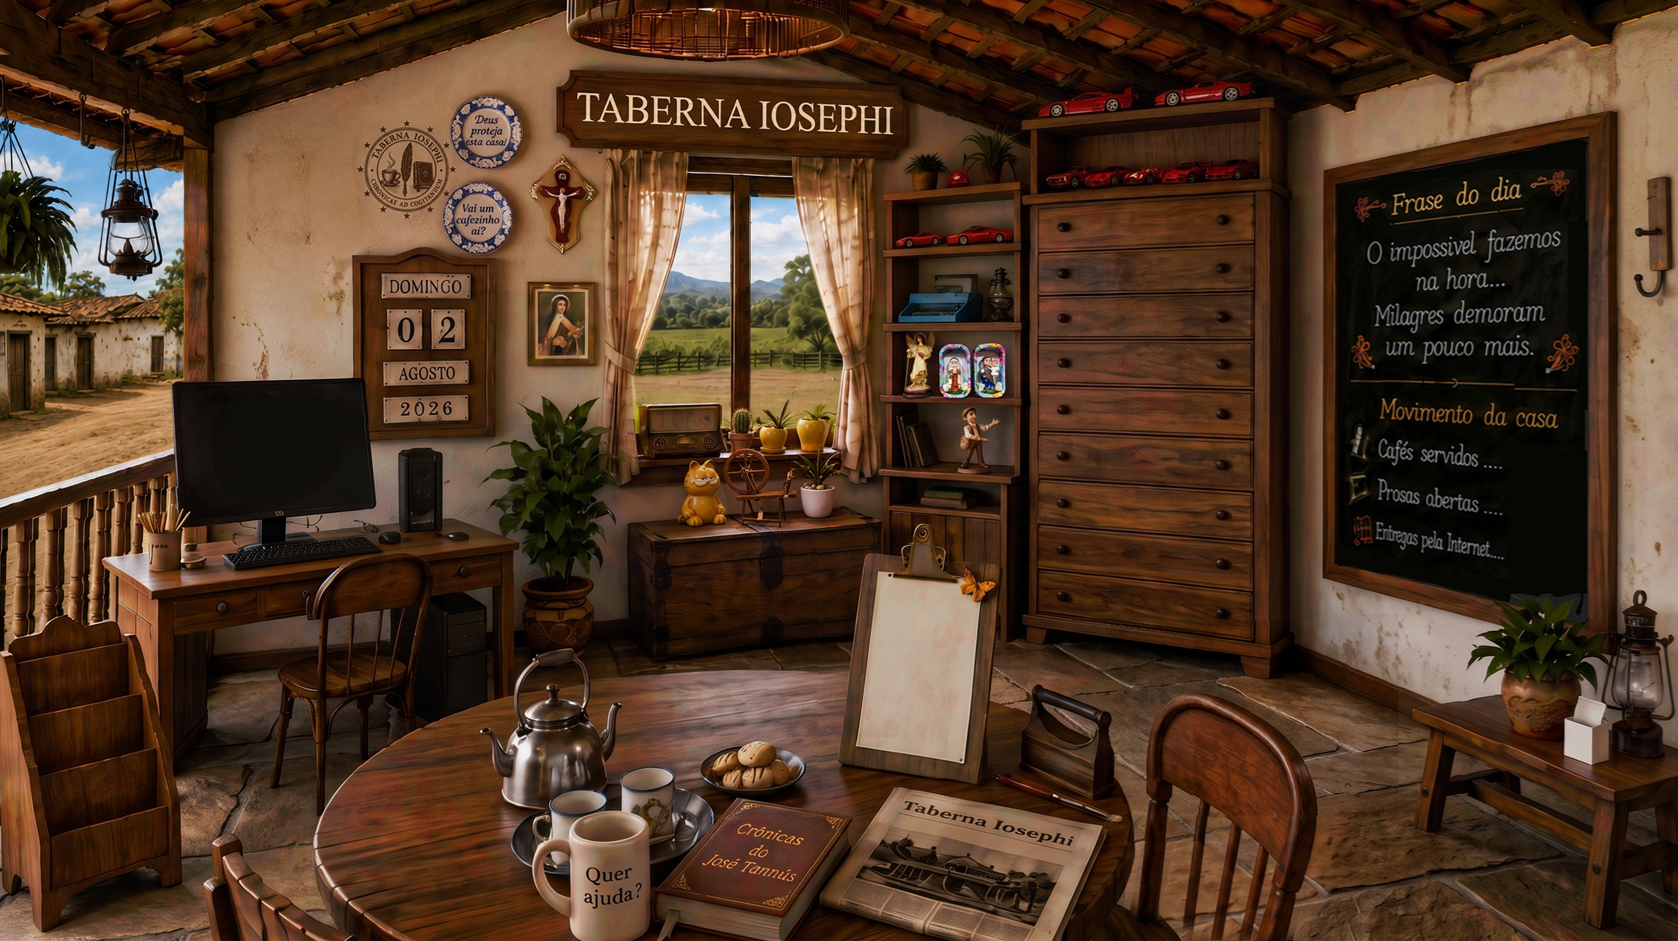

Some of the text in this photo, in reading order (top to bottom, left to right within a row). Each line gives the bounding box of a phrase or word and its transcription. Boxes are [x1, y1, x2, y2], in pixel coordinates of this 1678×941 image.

[474, 115, 498, 124] Deus
[577, 92, 894, 135] TABERNA IOSEPHI
[470, 126, 502, 138] proteja
[486, 138, 507, 146] casa!
[371, 132, 443, 163] TABERNA IOSEPHI
[370, 179, 397, 206] CHRONICAE
[410, 179, 443, 208] COGITANDUM
[1391, 176, 1522, 216] Frase do dia
[456, 215, 500, 226] cafezinho
[462, 204, 478, 212] Vai
[1366, 230, 1561, 268] O impossivel fazemos
[390, 280, 462, 294] DOMINGO
[1416, 268, 1506, 292] na hora...
[1374, 300, 1546, 334] Milagres demoram
[1385, 335, 1534, 364] um pouco mais.
[399, 366, 456, 380] AGOSTO
[400, 401, 452, 416] 2026
[1379, 397, 1559, 430] Movimento da casa
[1378, 438, 1414, 466] Cafés
[1420, 443, 1479, 468] servidos
[1377, 478, 1420, 504] Prosas
[1426, 487, 1480, 513] abertas
[1376, 522, 1418, 550] Entregas
[1421, 530, 1444, 554] pela
[736, 823, 804, 846] Crônicas
[903, 800, 1074, 847] Taberna Iosephi
[748, 844, 770, 858] do
[586, 866, 632, 886] Quer
[702, 854, 798, 883] José Tannús
[584, 882, 642, 910] ajuda?
